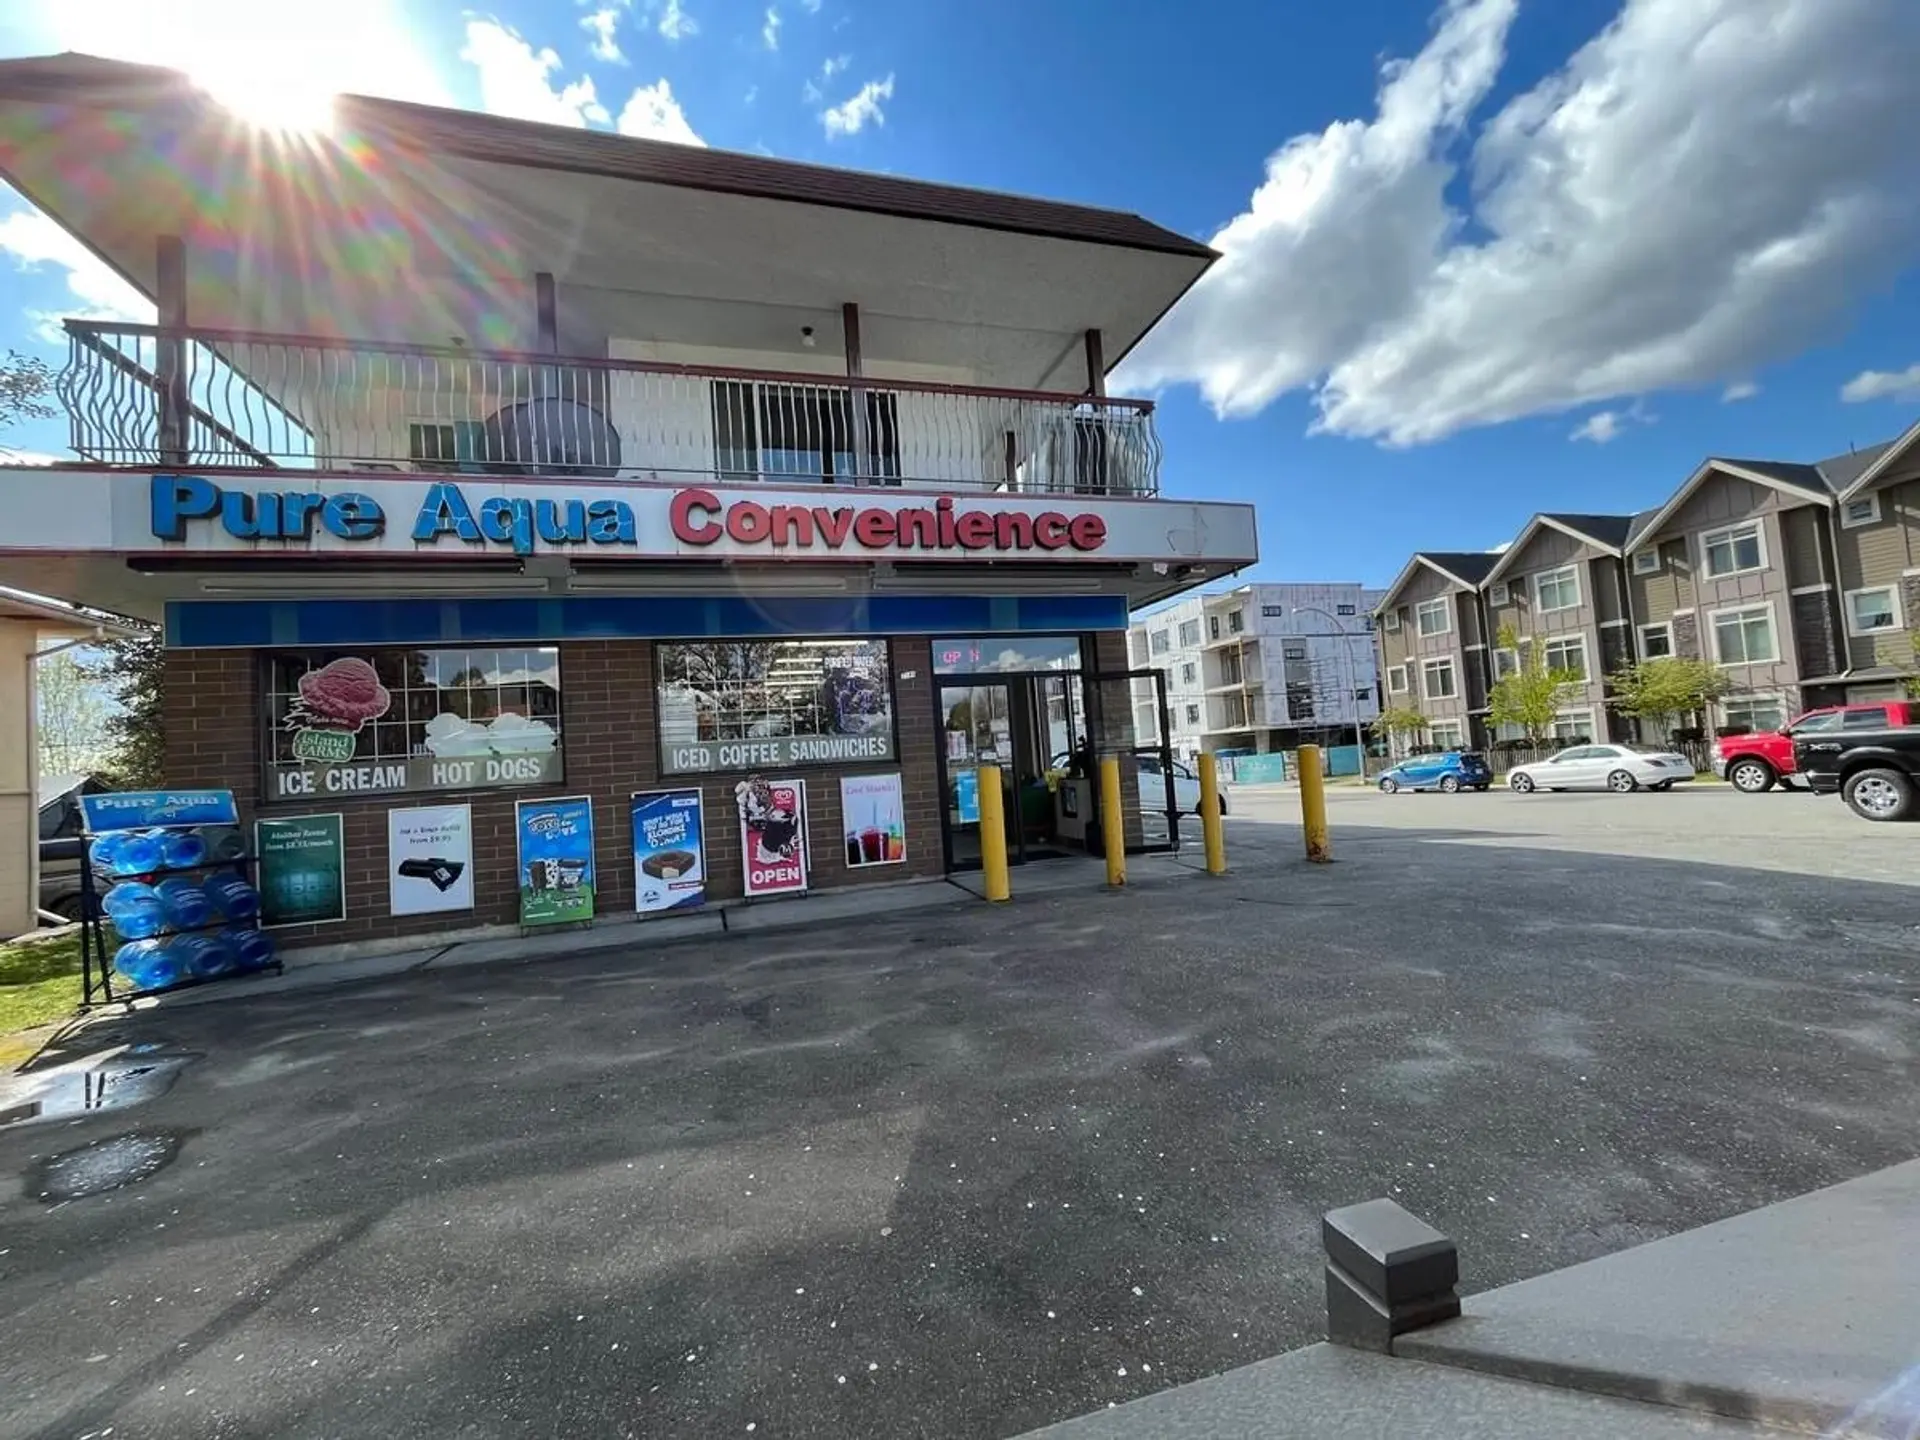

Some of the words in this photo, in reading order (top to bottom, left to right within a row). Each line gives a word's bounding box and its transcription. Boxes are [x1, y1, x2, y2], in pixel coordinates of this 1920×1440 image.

[149, 474, 386, 542] Pure
[412, 481, 638, 556] Aqua
[669, 487, 1108, 551] Convenience
[297, 744, 349, 758] FARMS
[672, 747, 711, 769] ICED
[719, 743, 779, 765] COFFEE
[789, 736, 887, 760] SANDWICHES
[278, 771, 316, 795] ICE
[325, 765, 406, 791] CREAM
[432, 761, 475, 785] HOT
[486, 757, 541, 782] DOGS
[95, 798, 155, 810] Pure
[165, 795, 219, 807] Aqua
[751, 866, 800, 885] OPEN
